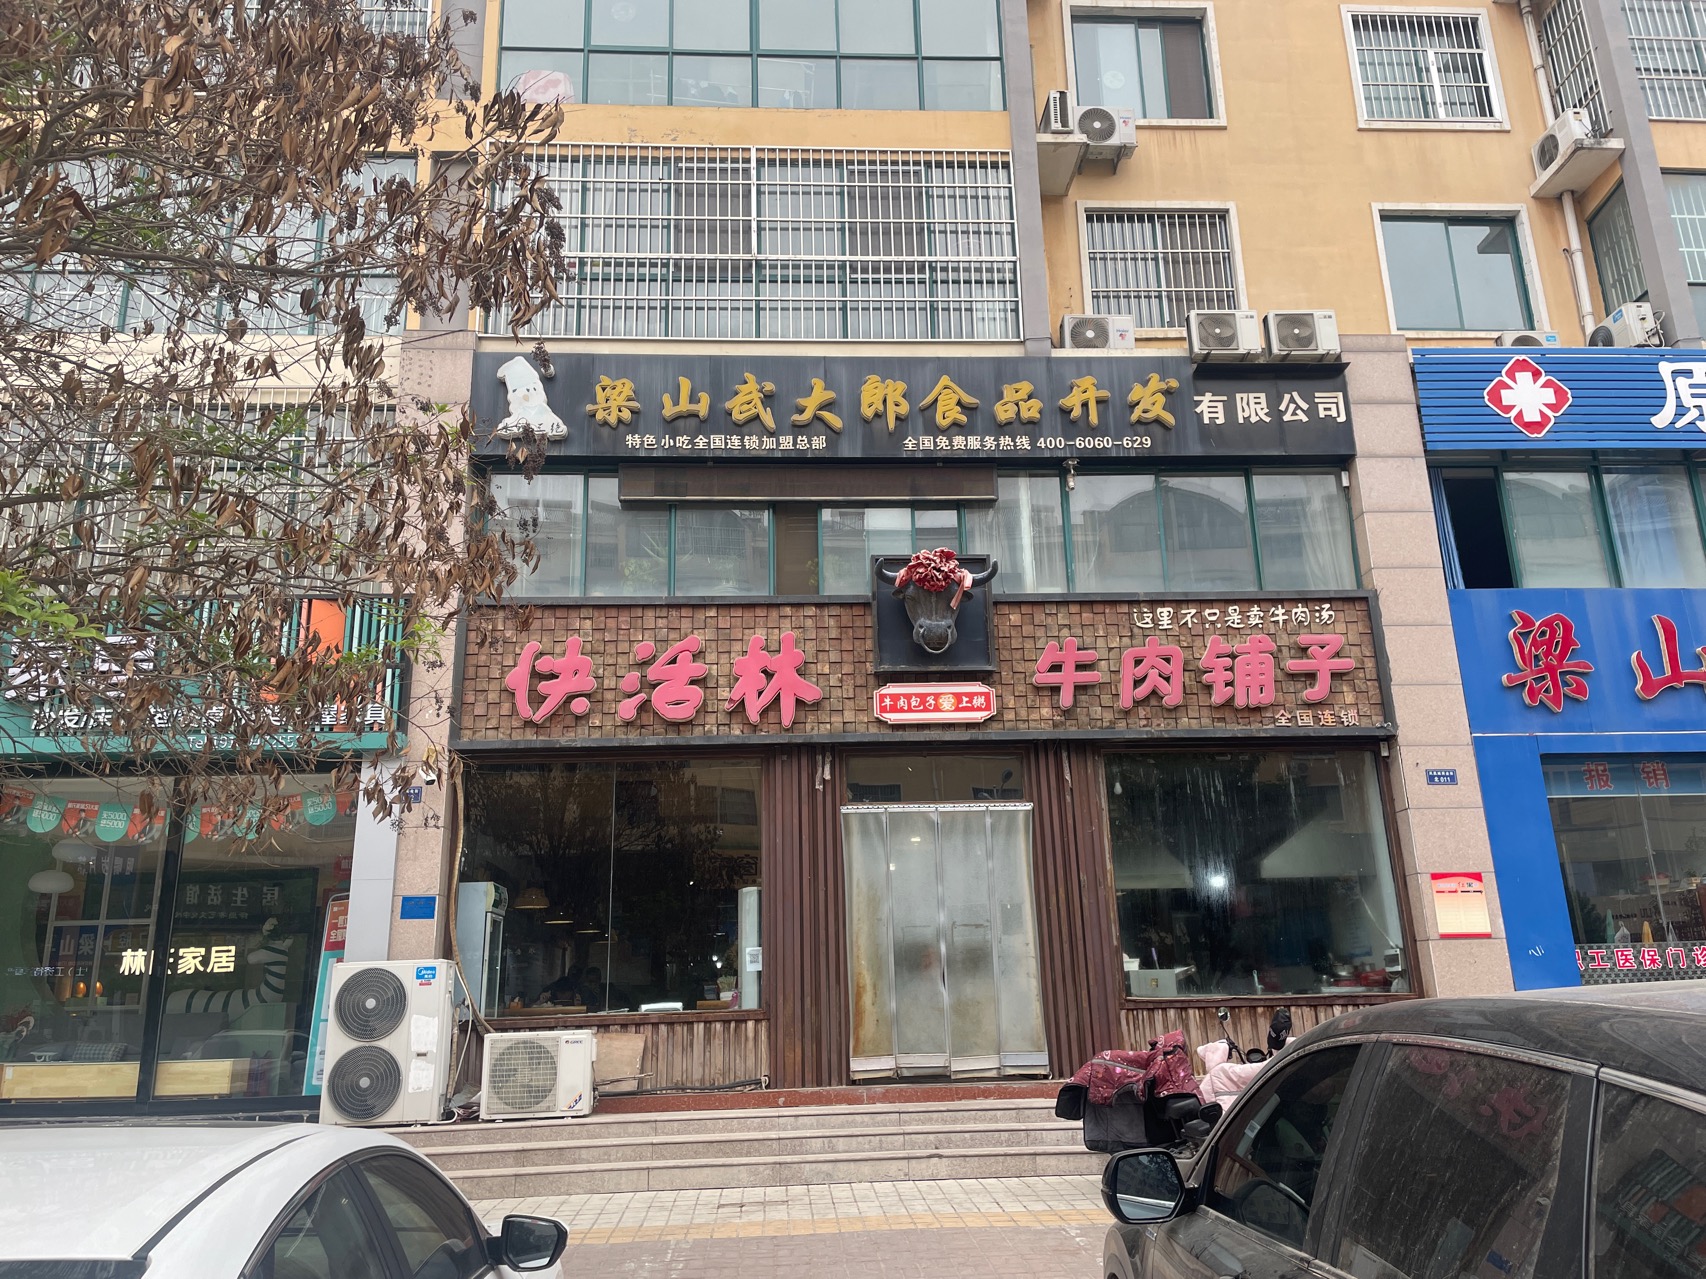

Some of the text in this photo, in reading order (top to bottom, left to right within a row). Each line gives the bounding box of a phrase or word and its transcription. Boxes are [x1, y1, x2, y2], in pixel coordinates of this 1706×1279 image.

[585, 372, 1348, 434] 梁山武大郎食品开发 有限公司
[625, 433, 827, 450] 特色小吃全国连锁加盟总部
[902, 435, 1152, 451] 全国免费服务热线 400-6060-629
[1133, 604, 1335, 629] 这里不只是卖牛肉汤
[505, 631, 823, 728] 快活林
[1033, 634, 1355, 710] 牛肉铺子
[881, 693, 987, 712] 牛肉包子爱上粥
[1275, 710, 1359, 727] 全国连锁
[1582, 761, 1671, 790] 报销
